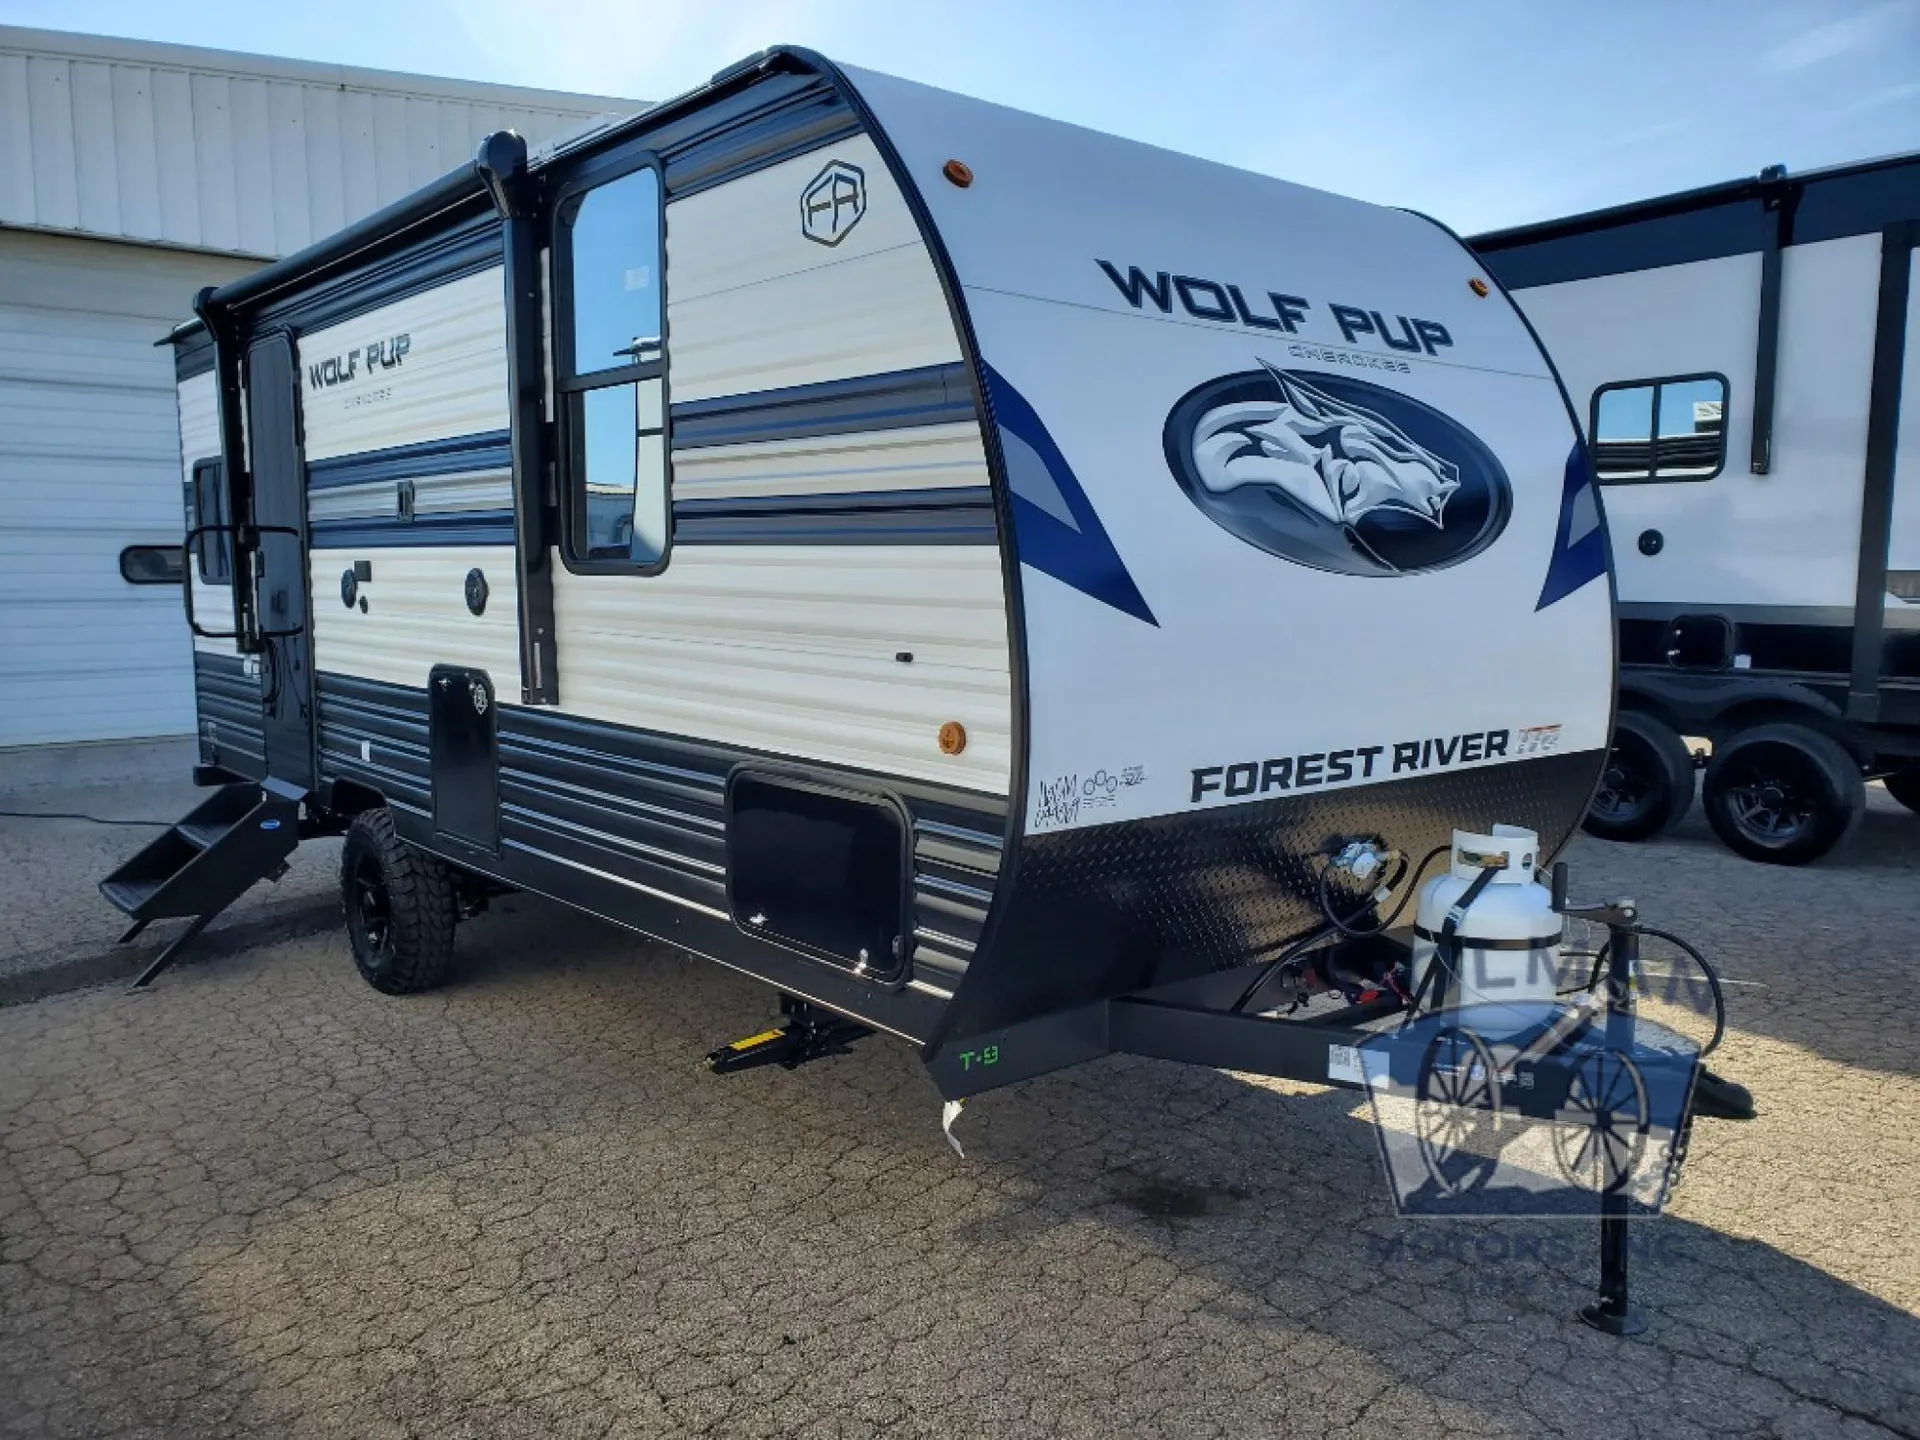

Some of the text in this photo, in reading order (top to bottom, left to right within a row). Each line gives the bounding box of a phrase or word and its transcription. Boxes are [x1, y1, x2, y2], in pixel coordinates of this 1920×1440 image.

[1094, 257, 1455, 357] WOLF PUP
[308, 333, 411, 390] WOLF PUP
[1287, 345, 1411, 374] CHEROKEE
[1190, 744, 1384, 803] FOREST
[1392, 728, 1510, 774] RIVER
